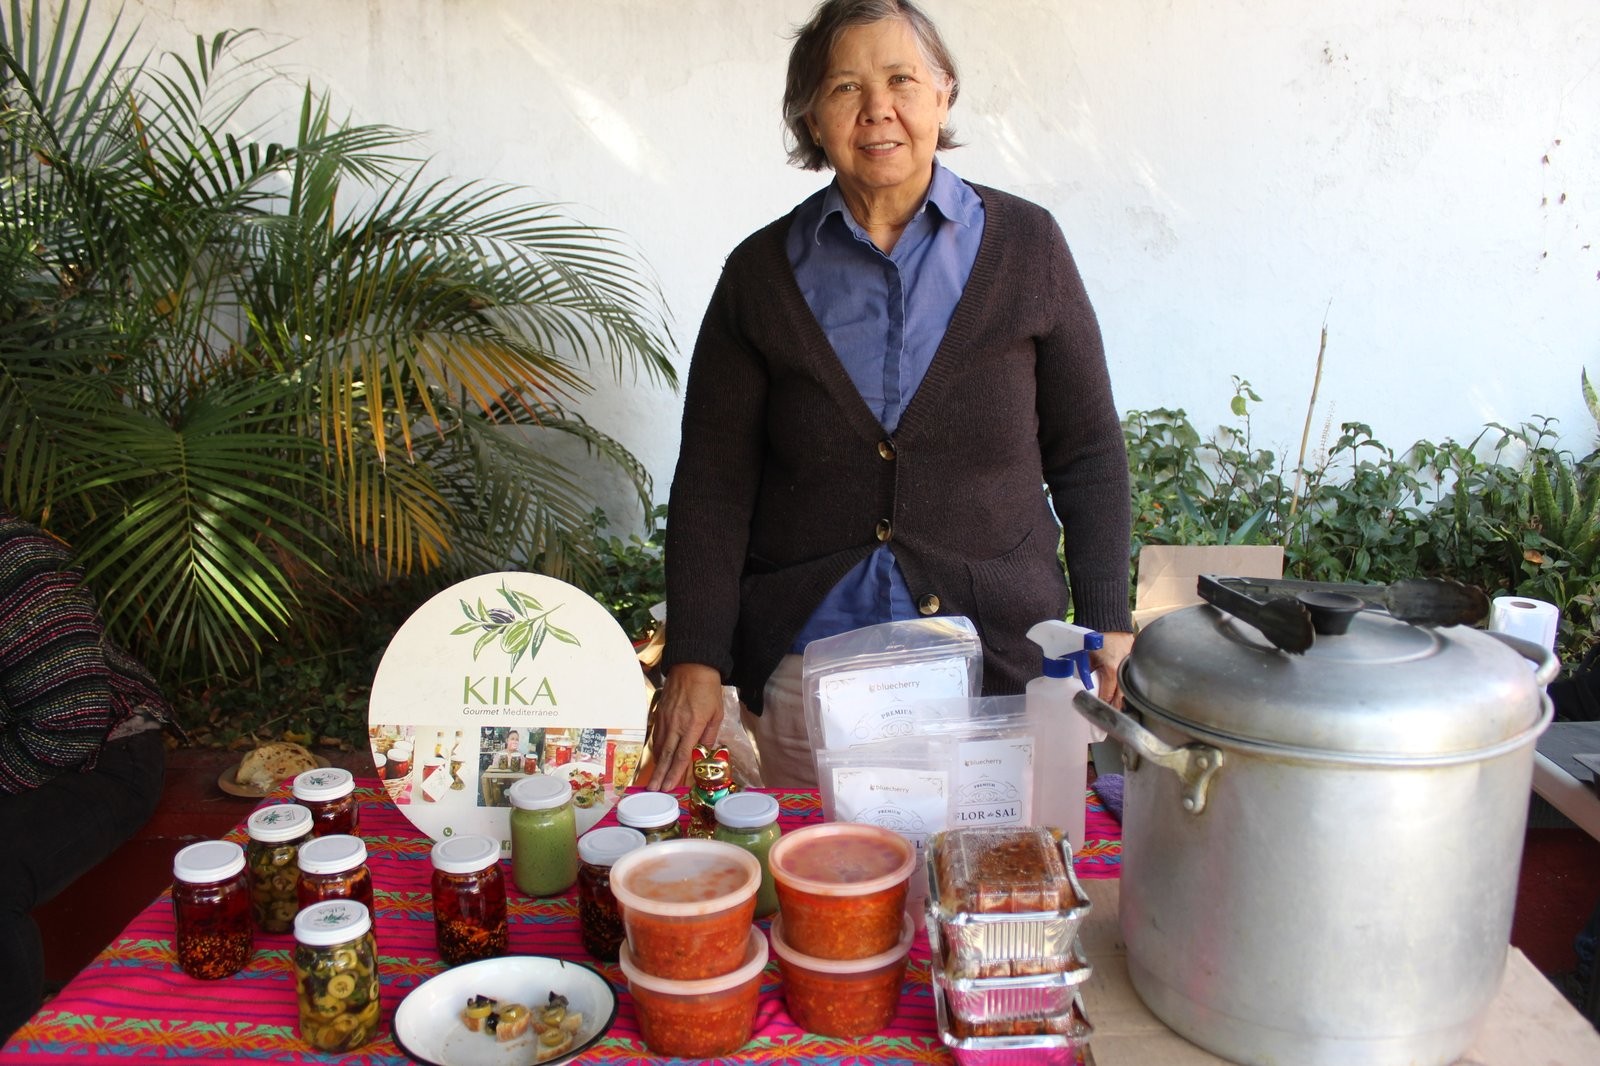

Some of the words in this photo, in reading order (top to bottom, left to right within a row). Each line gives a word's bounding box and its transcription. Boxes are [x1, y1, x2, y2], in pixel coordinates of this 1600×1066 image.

[876, 679, 921, 691] bluecherry
[463, 676, 557, 706] KIKA
[462, 707, 499, 716] Gourmet
[995, 808, 1017, 819] SAL
